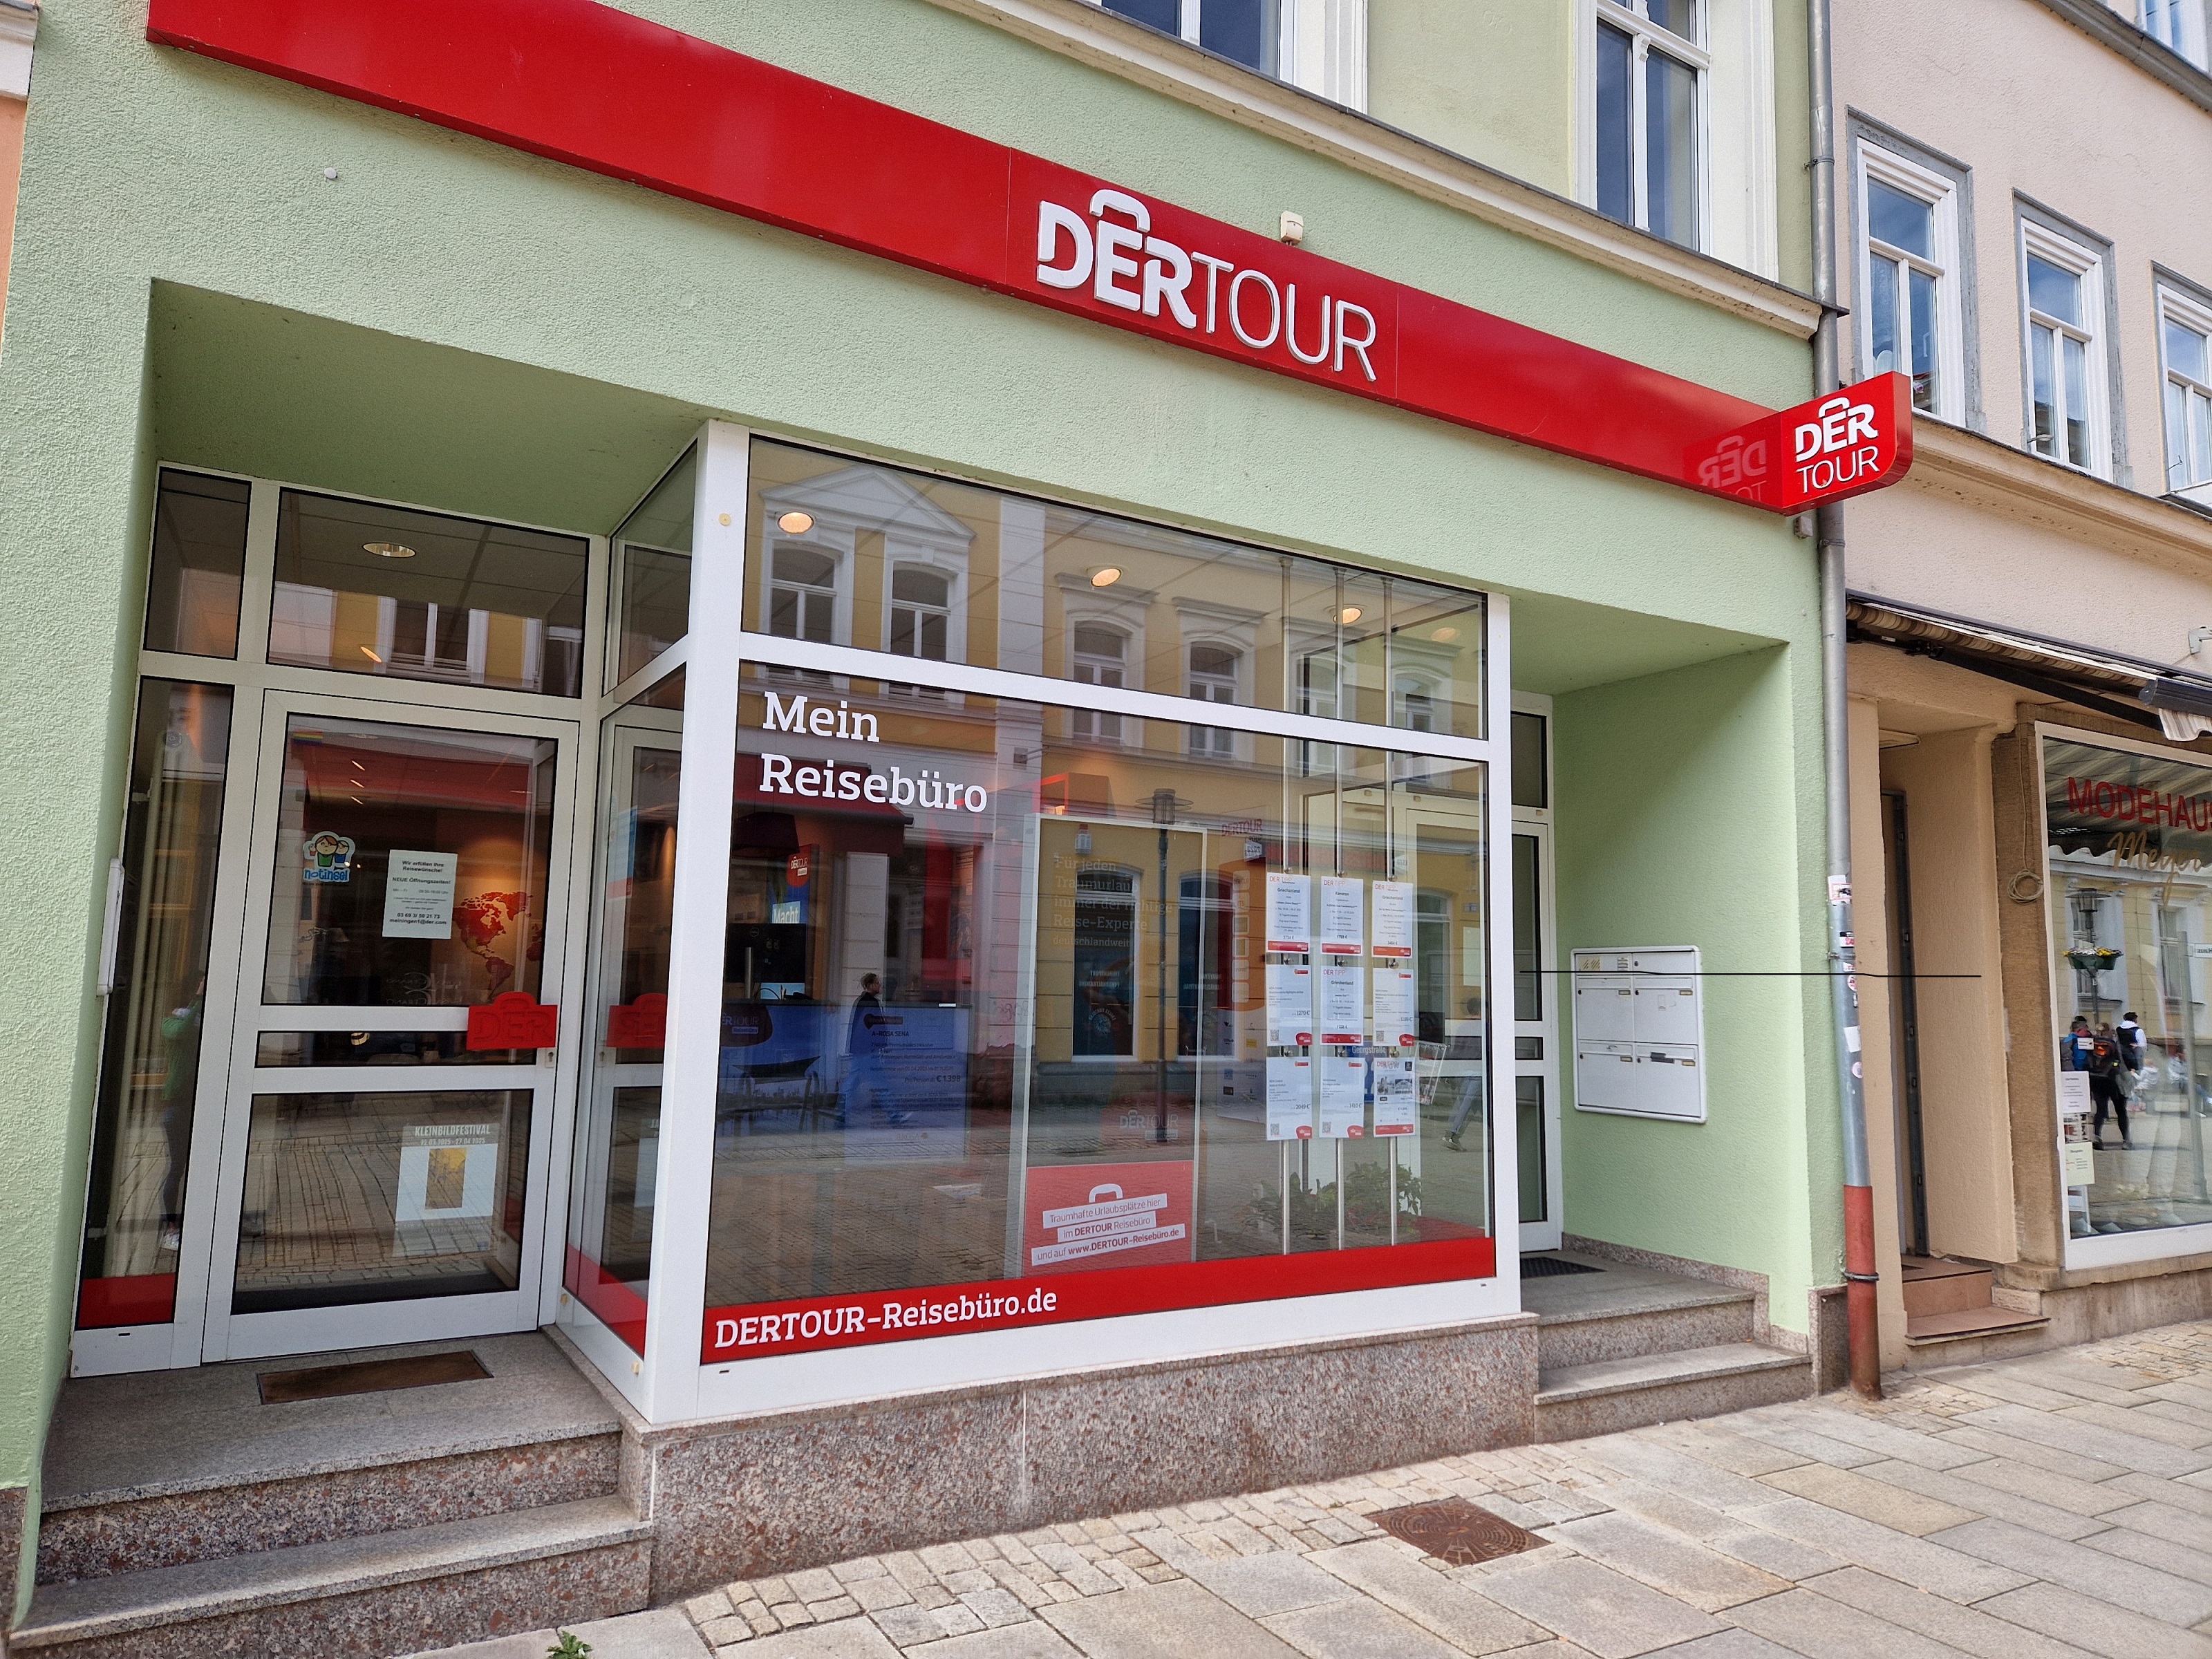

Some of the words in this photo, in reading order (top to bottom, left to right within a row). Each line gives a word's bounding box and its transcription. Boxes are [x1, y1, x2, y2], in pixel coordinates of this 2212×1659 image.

[1038, 200, 1376, 382] DERTOUR
[1795, 404, 1878, 462] DER
[1797, 446, 1880, 493] TOUR
[762, 691, 879, 742] Mein
[759, 753, 987, 812] Reisebüro
[2068, 776, 2212, 832] MODEHAU
[1056, 856, 1079, 868] Für
[1082, 859, 1117, 872] jeden
[305, 869, 348, 881] notinsel
[1056, 875, 1139, 892] Traumurlaub
[1054, 895, 1100, 909] immer
[1101, 897, 1123, 910] der
[774, 906, 799, 924] Macht
[1053, 914, 1147, 931] Reise-Experte
[1053, 936, 1130, 946] deutschlandweit
[722, 1016, 759, 1026] ERTOUR
[415, 1125, 490, 1136] KLEINBILDFESTIVAL
[1120, 1114, 1178, 1129] DERTOUR
[1050, 1210, 1093, 1224] Traumhafte
[1095, 1202, 1145, 1216] Urlaubsplätze
[1147, 1199, 1161, 1208] hier
[1063, 1230, 1073, 1238] im
[1075, 1223, 1112, 1236] DERTOUR
[1114, 1218, 1150, 1230] Reisebüro
[1038, 1250, 1052, 1260] und
[1054, 1248, 1066, 1257] auf
[1068, 1228, 1179, 1255] www.DERTOUR-Reisebüro.de
[715, 1288, 1057, 1348] DERTOUR-Reisebüro.de
